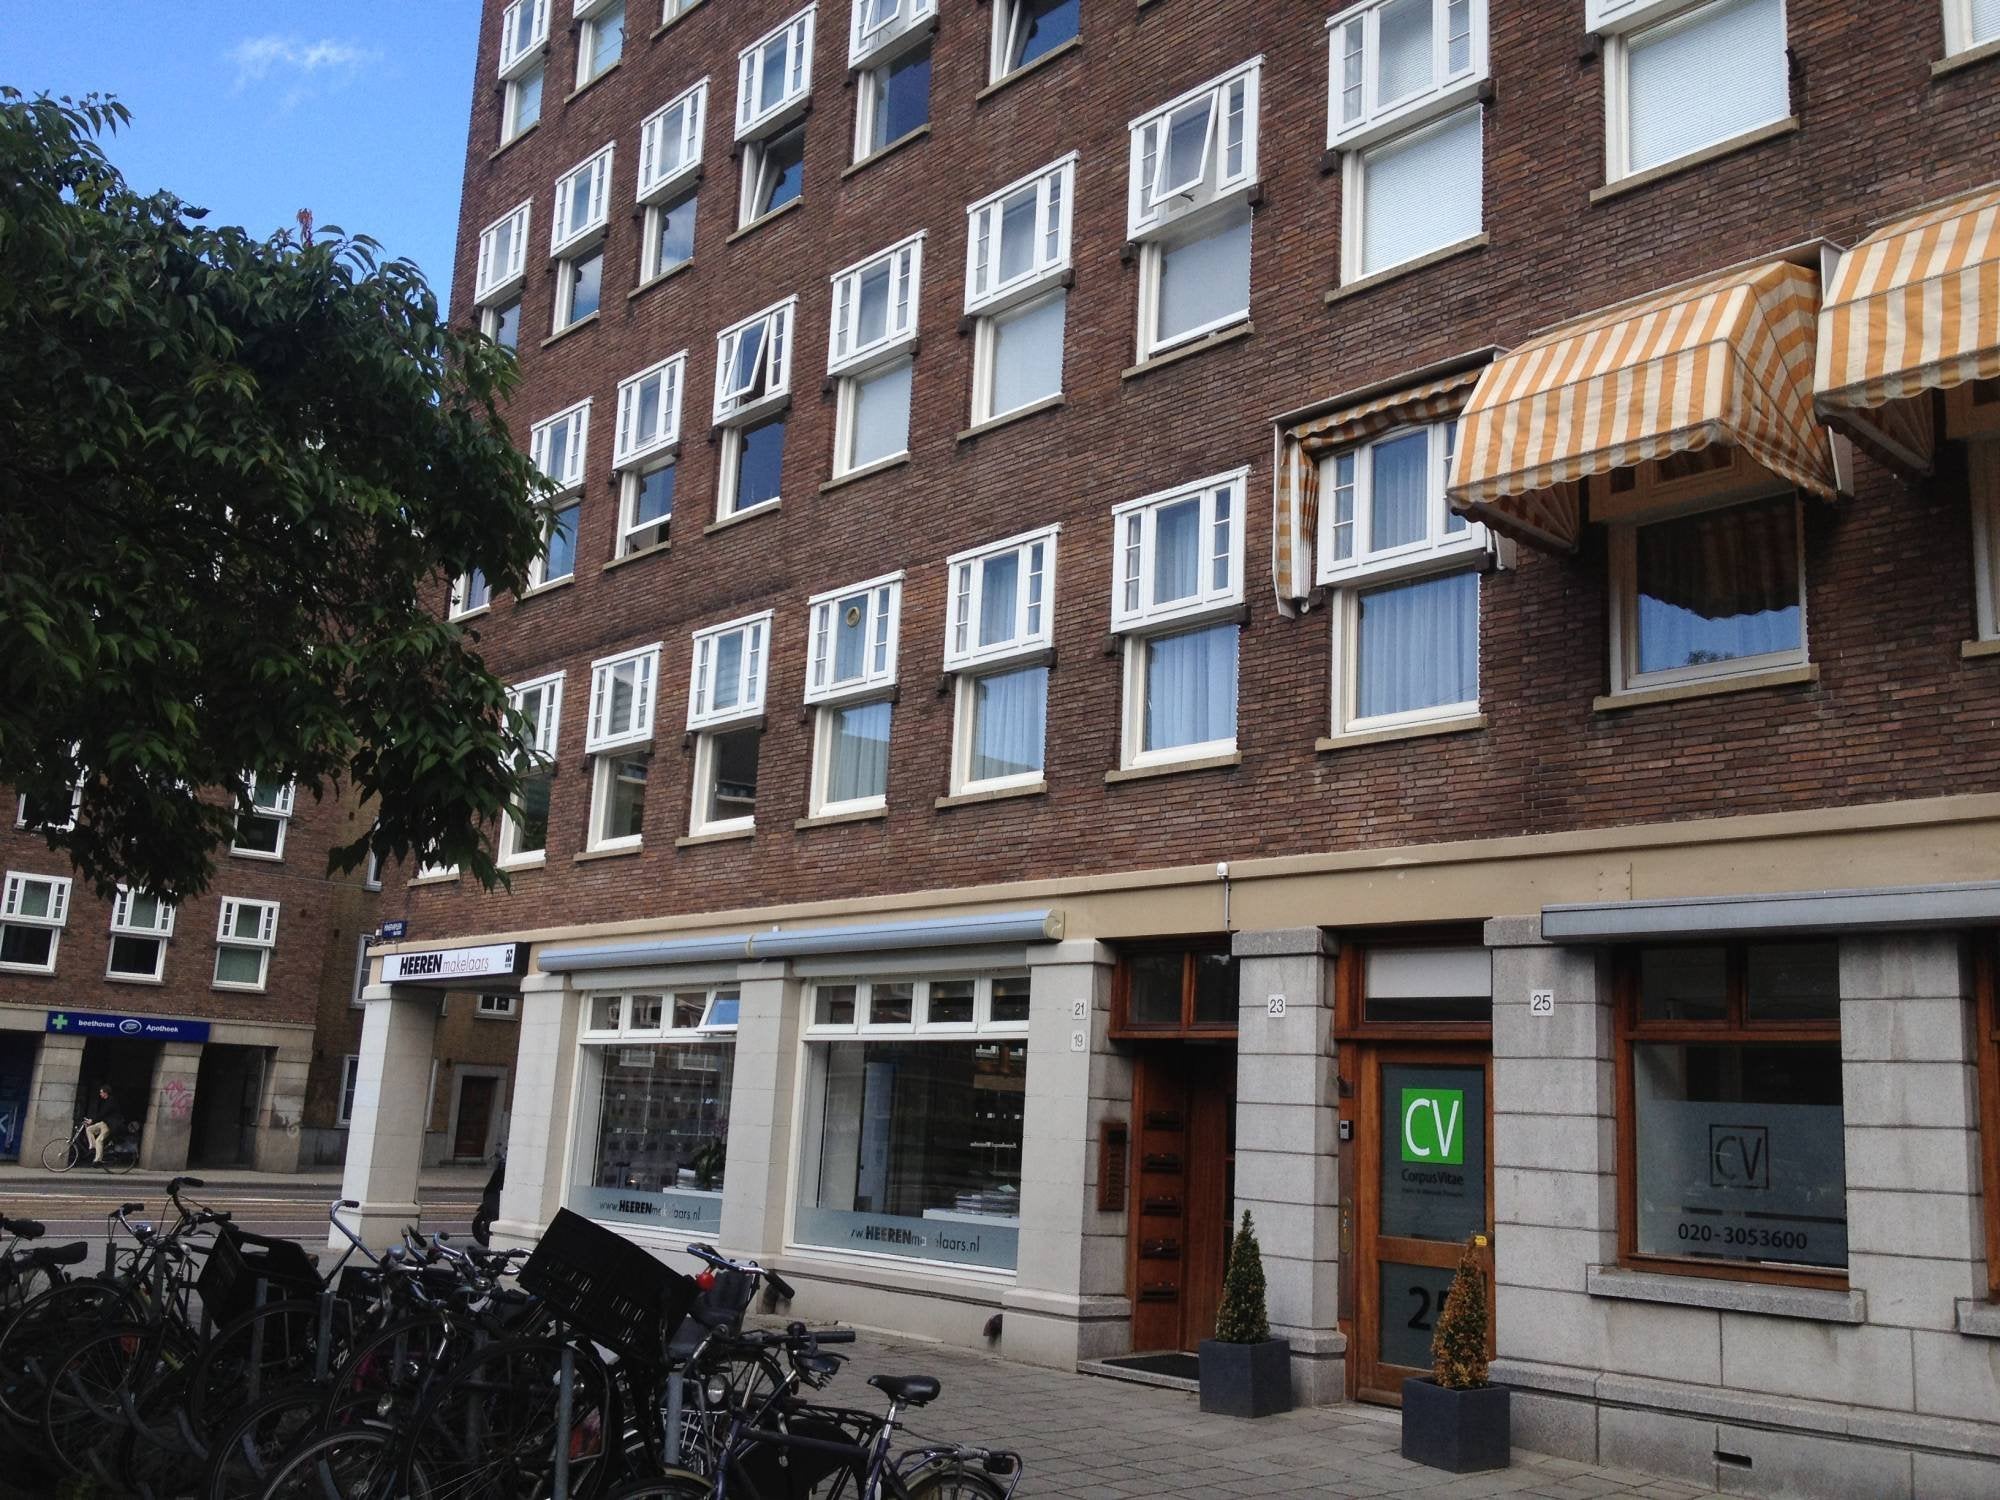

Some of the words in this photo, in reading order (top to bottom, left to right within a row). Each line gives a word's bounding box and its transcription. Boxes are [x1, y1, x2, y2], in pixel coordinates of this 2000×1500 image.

[1074, 1002, 1085, 1016] 21
[1269, 998, 1284, 1014] 23
[1533, 993, 1551, 1011] 25
[1073, 1033, 1084, 1048] 19
[1405, 1097, 1459, 1157] CV
[1715, 1135, 1762, 1181] CV
[1401, 1167, 1437, 1186] Corpus
[1678, 1222, 1808, 1250] 020-3053600
[1407, 1286, 1449, 1331] 2
